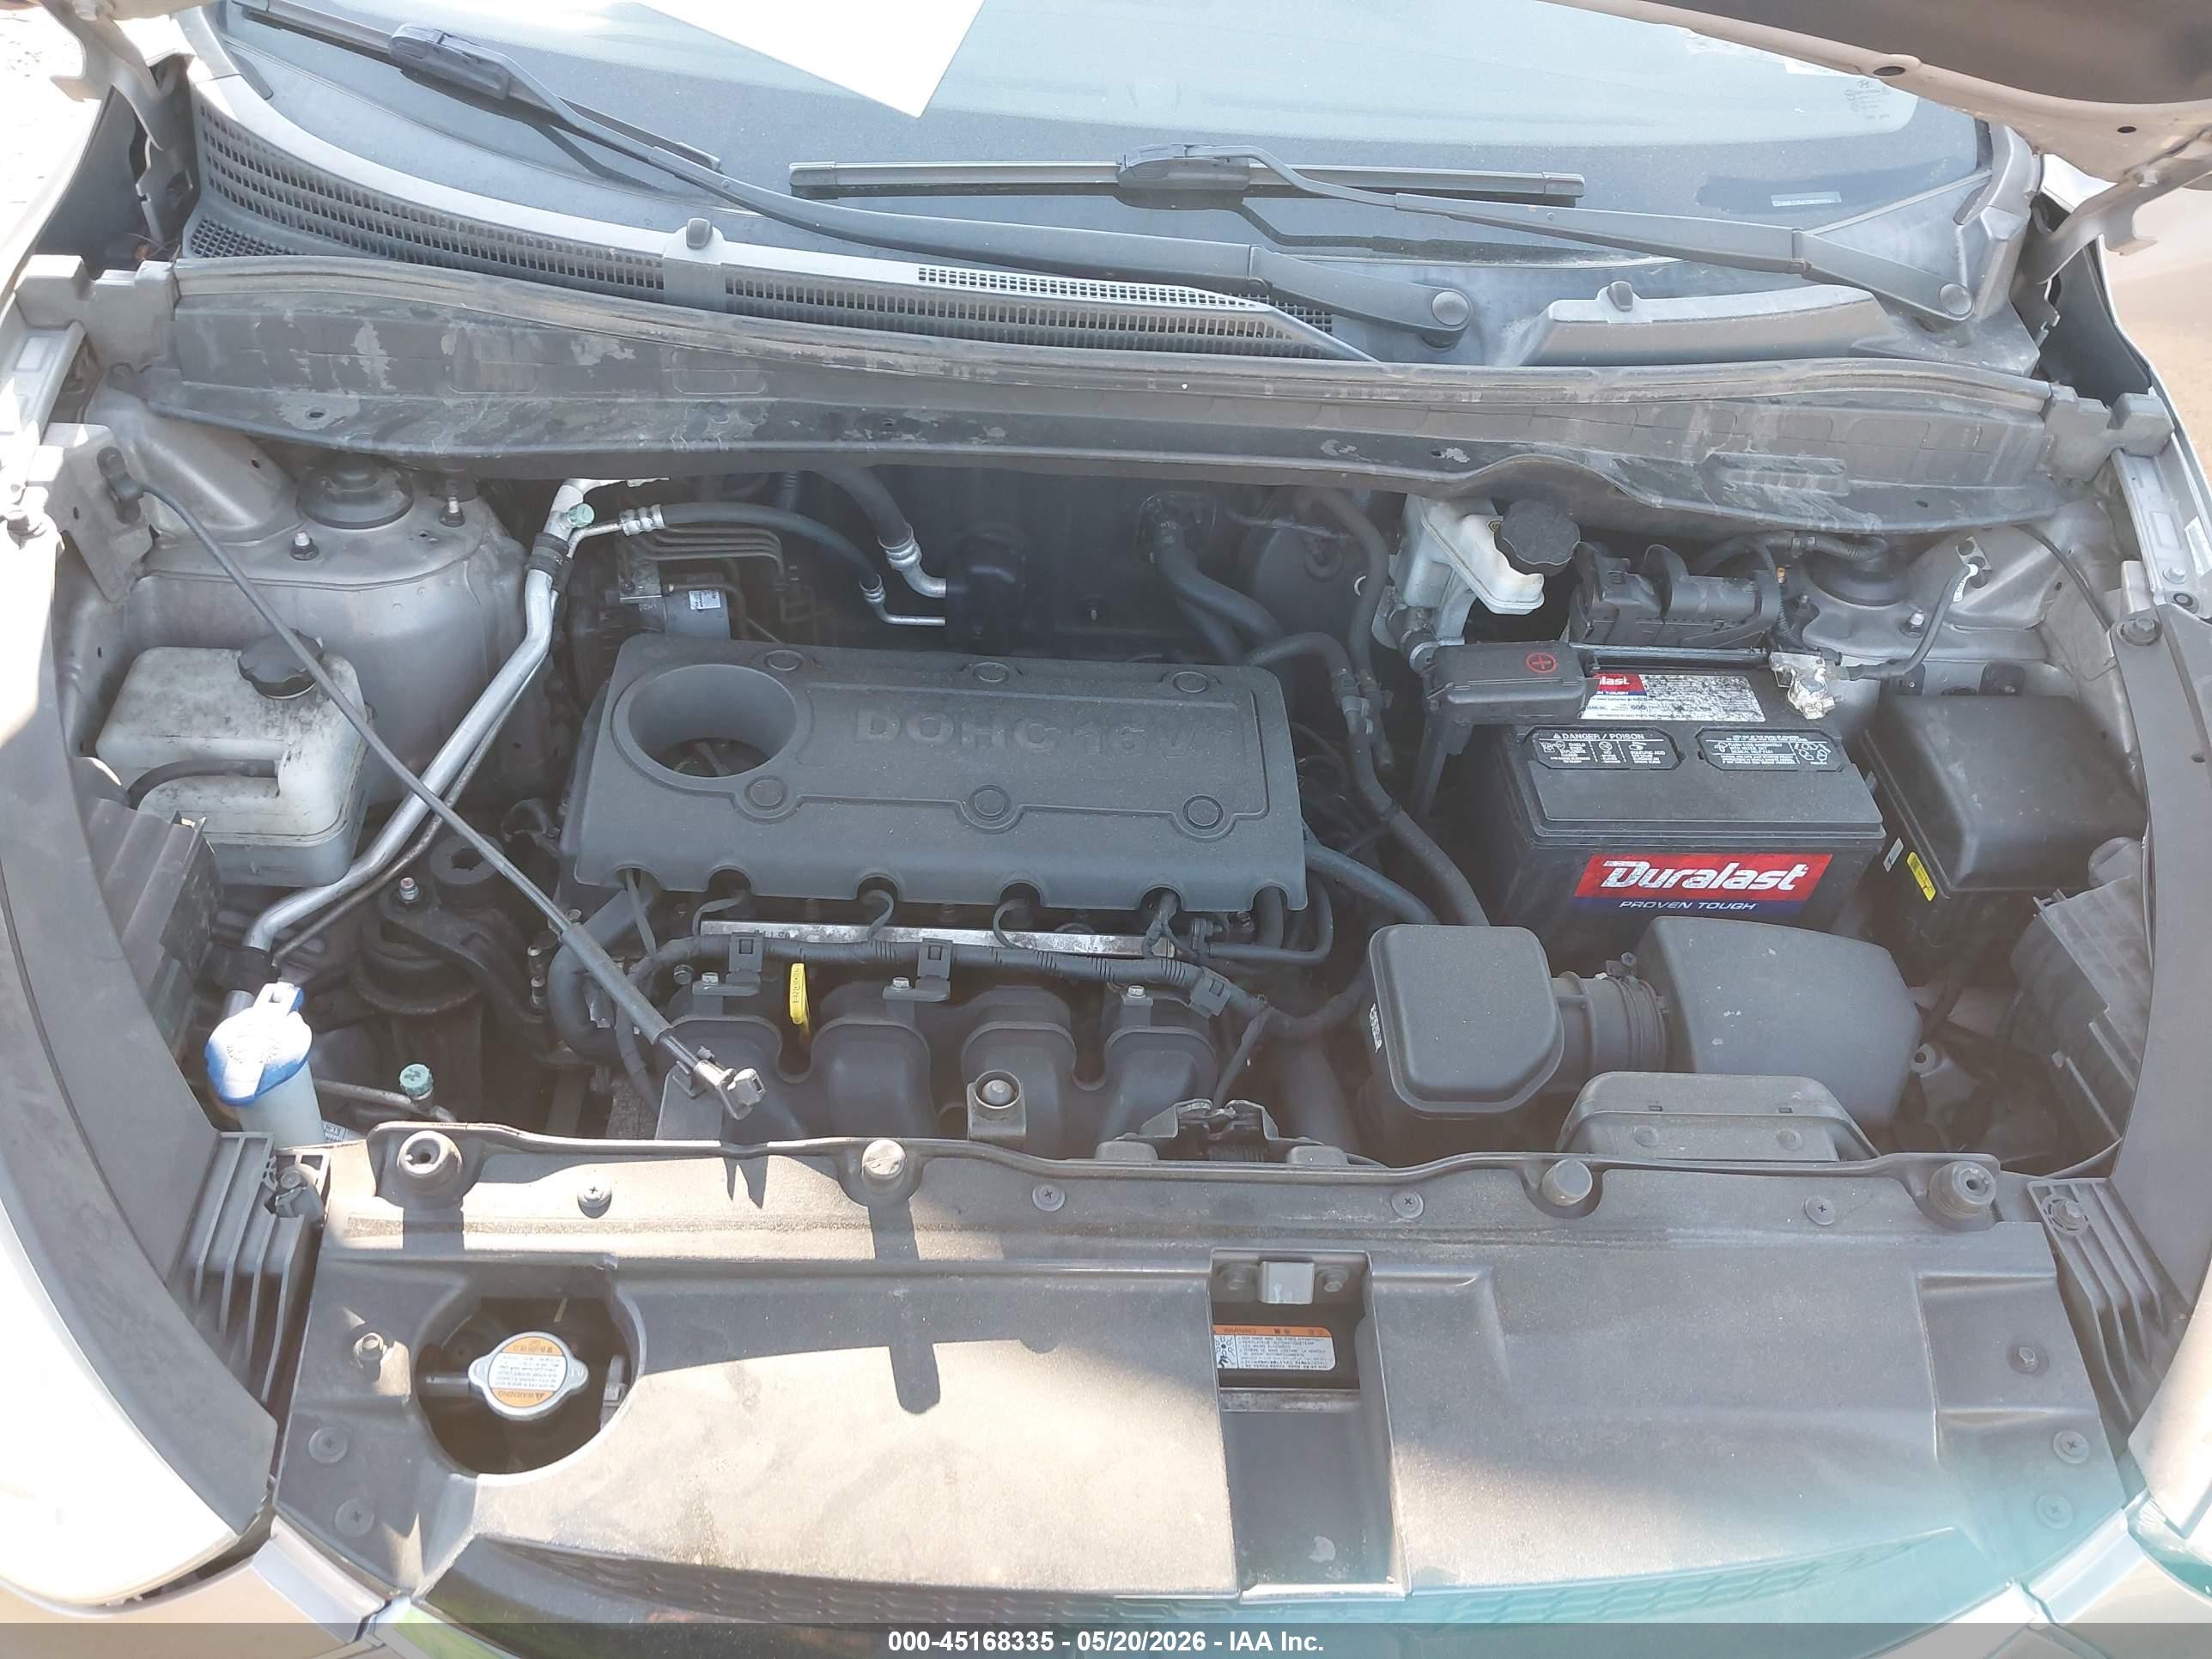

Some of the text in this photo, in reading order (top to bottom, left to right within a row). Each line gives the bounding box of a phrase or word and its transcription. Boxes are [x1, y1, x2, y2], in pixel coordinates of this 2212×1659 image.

[1599, 676, 1630, 685] last
[855, 712, 1060, 756] DOHC
[1601, 860, 1808, 890] Duralast
[1619, 901, 1758, 910] PROVEN TOUGH
